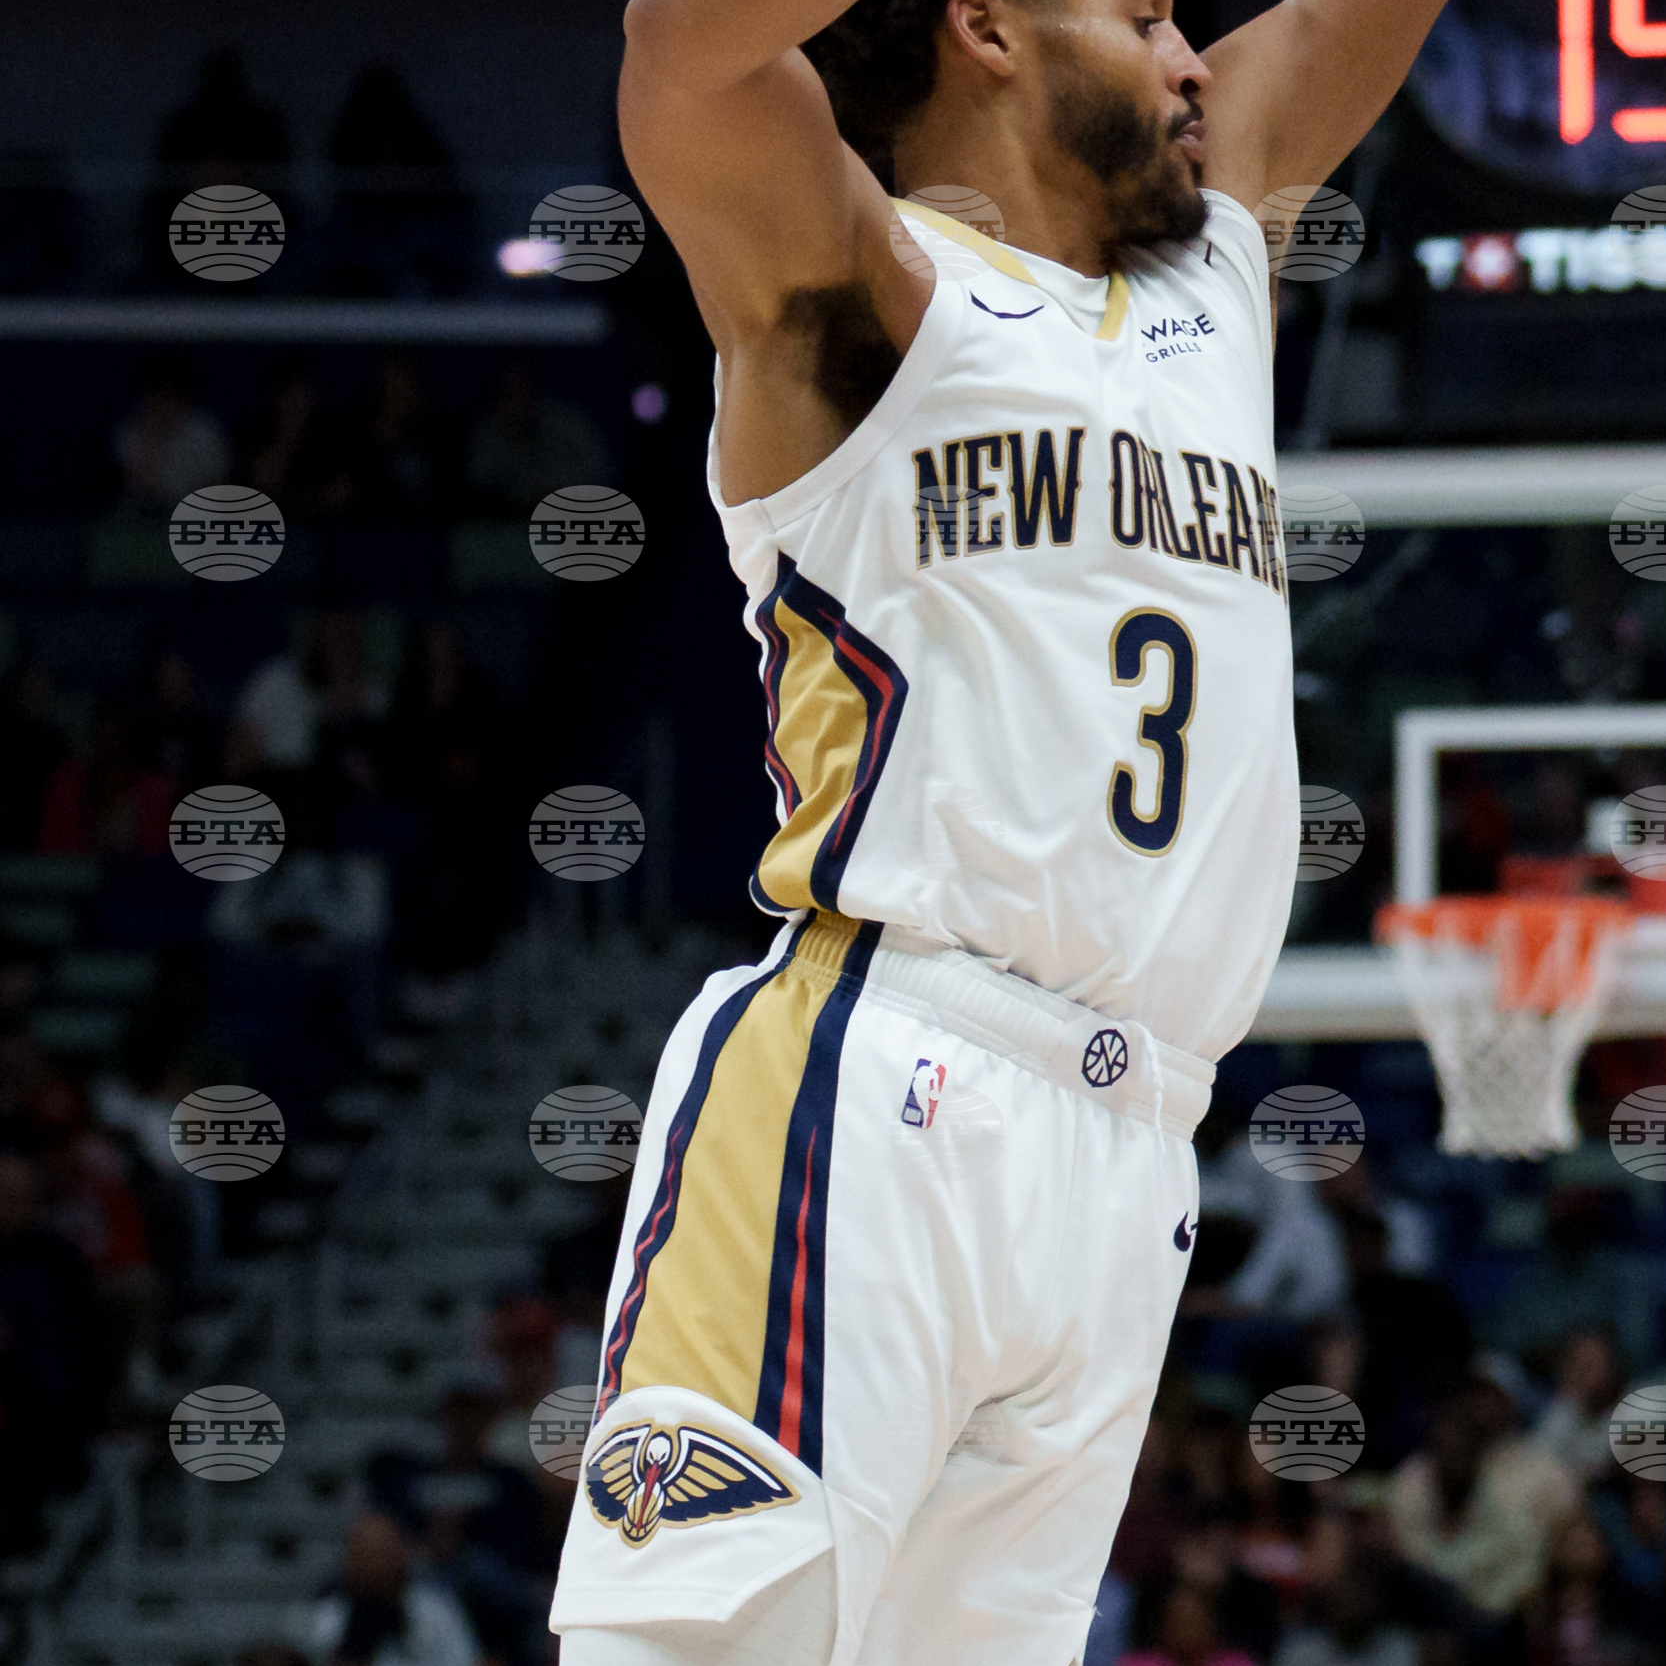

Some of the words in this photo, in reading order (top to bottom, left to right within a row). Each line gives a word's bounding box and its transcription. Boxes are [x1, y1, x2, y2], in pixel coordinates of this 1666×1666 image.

[1140, 312, 1216, 343] WAGE
[1145, 341, 1203, 363] GRILLS
[912, 426, 1088, 570] NEW
[1109, 428, 1289, 605] ORLEAN
[1107, 605, 1199, 859] 3
